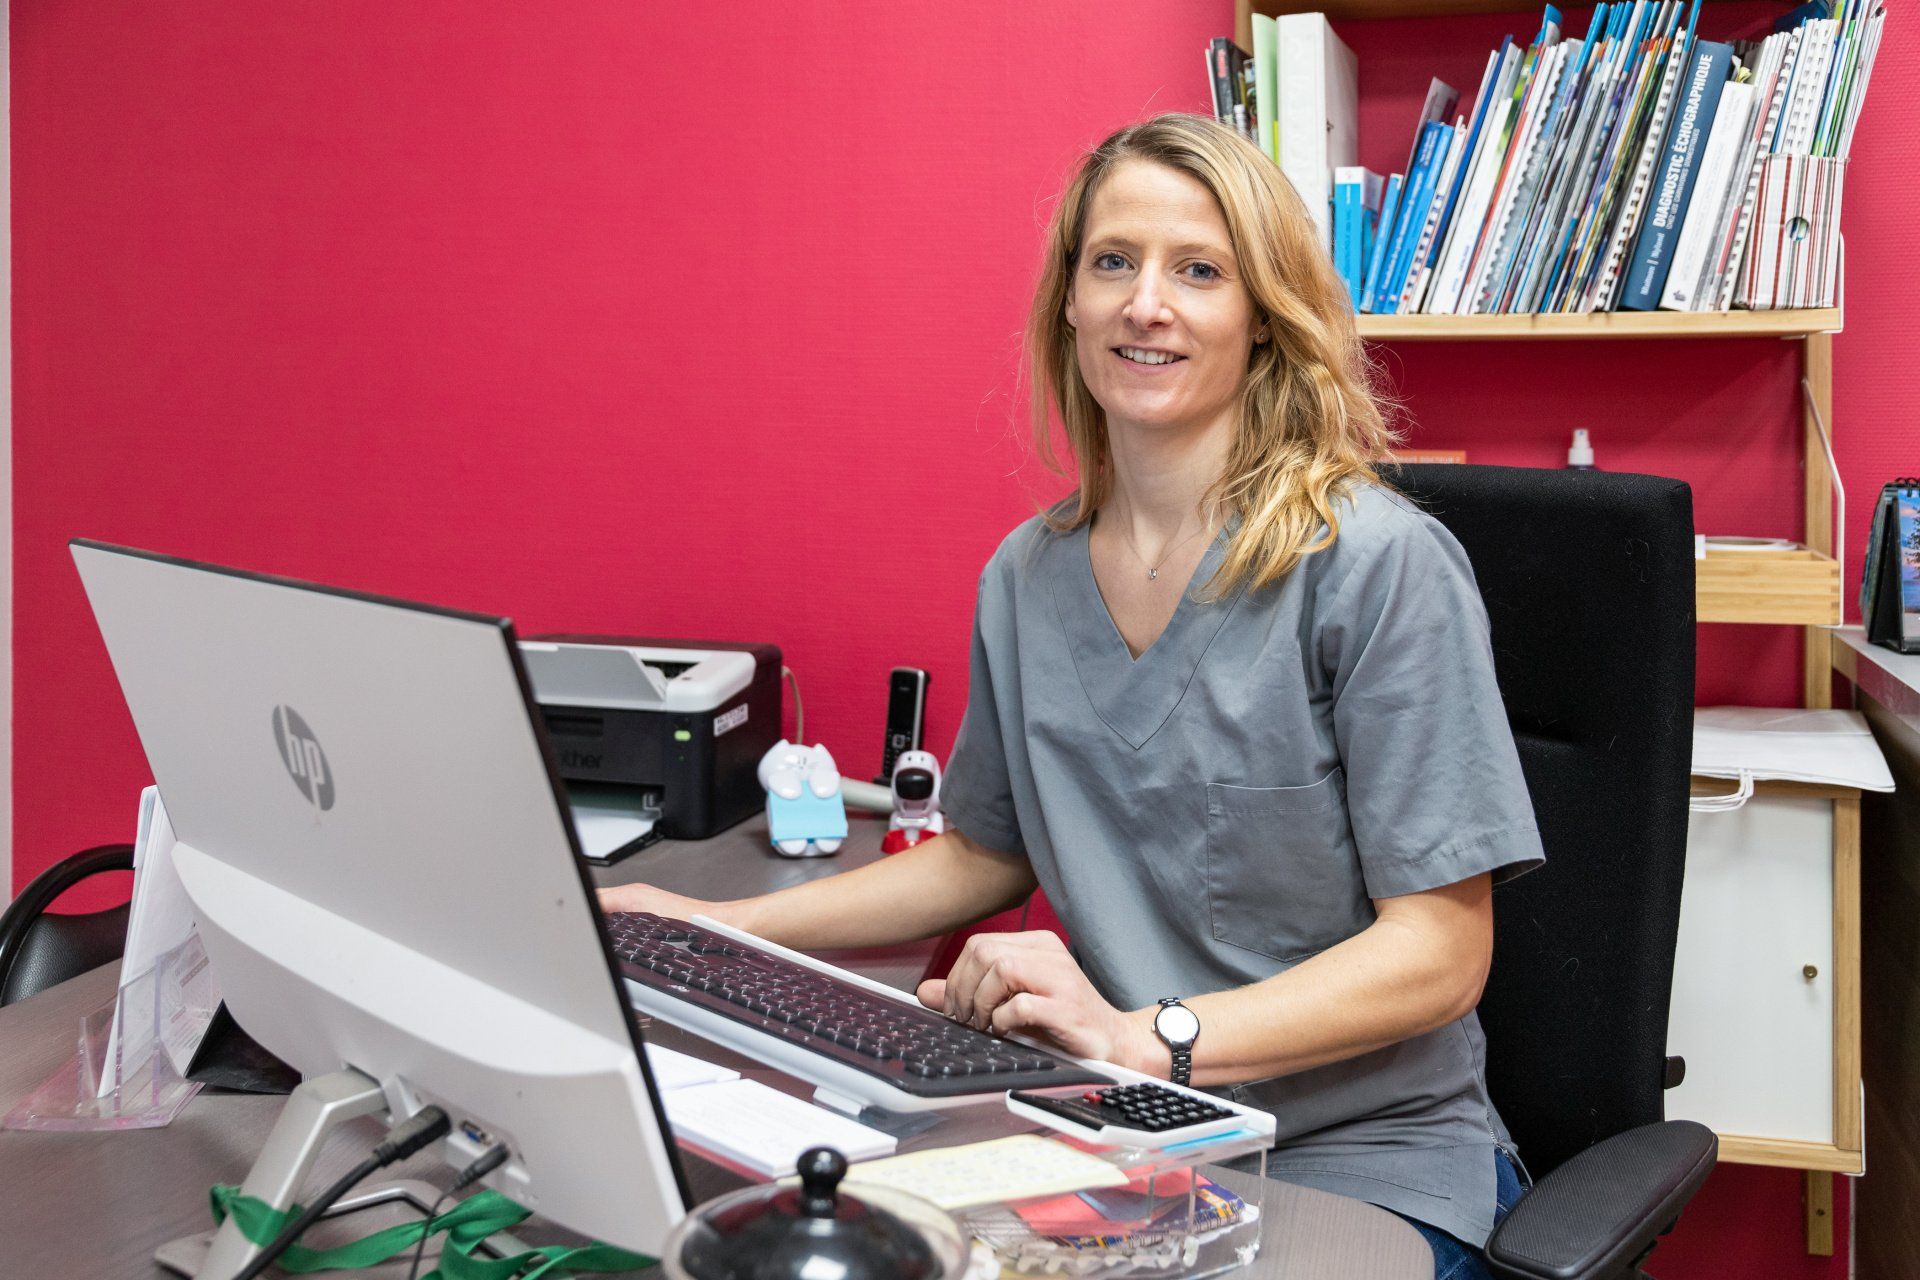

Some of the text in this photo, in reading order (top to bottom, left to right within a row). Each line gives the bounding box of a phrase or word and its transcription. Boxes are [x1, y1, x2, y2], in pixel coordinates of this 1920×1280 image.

[1651, 151, 1685, 228] DIAGNOSTIC
[1670, 51, 1714, 153] ÉCHOGRAPHIQUE
[279, 703, 326, 812] hp
